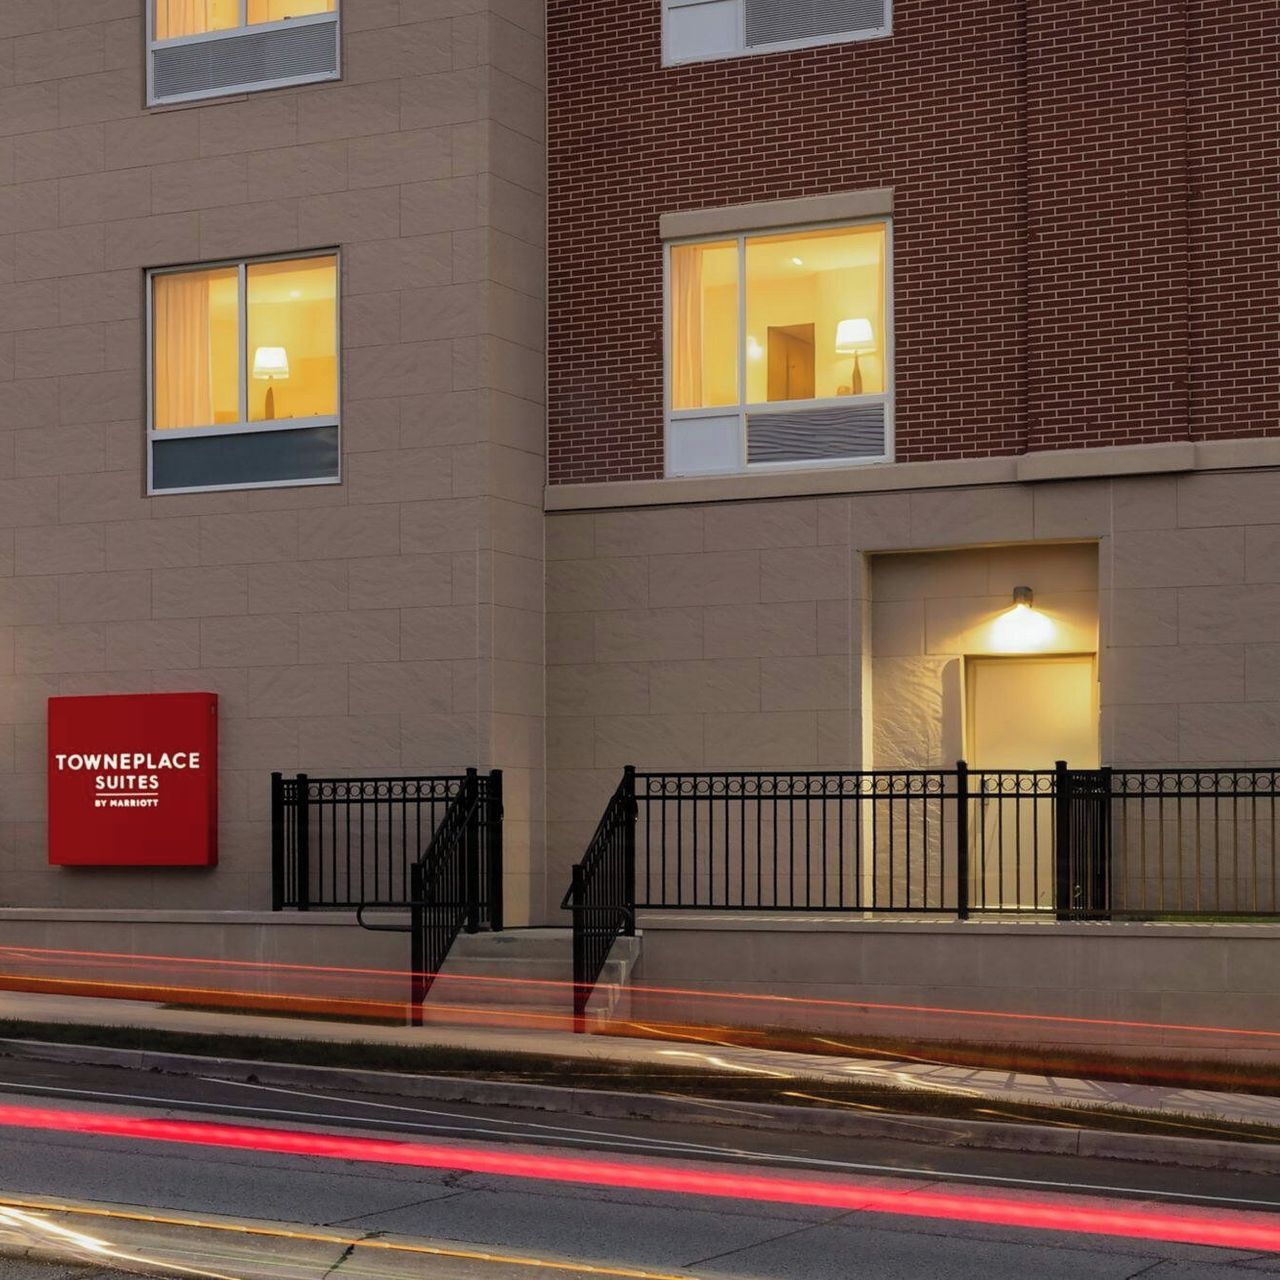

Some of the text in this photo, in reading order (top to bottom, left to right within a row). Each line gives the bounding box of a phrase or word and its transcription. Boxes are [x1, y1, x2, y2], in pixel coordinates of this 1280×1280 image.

[55, 752, 200, 771] TOWNEPLACE
[95, 774, 159, 790] SUITES
[95, 798, 159, 808] BY MARRIOTT
